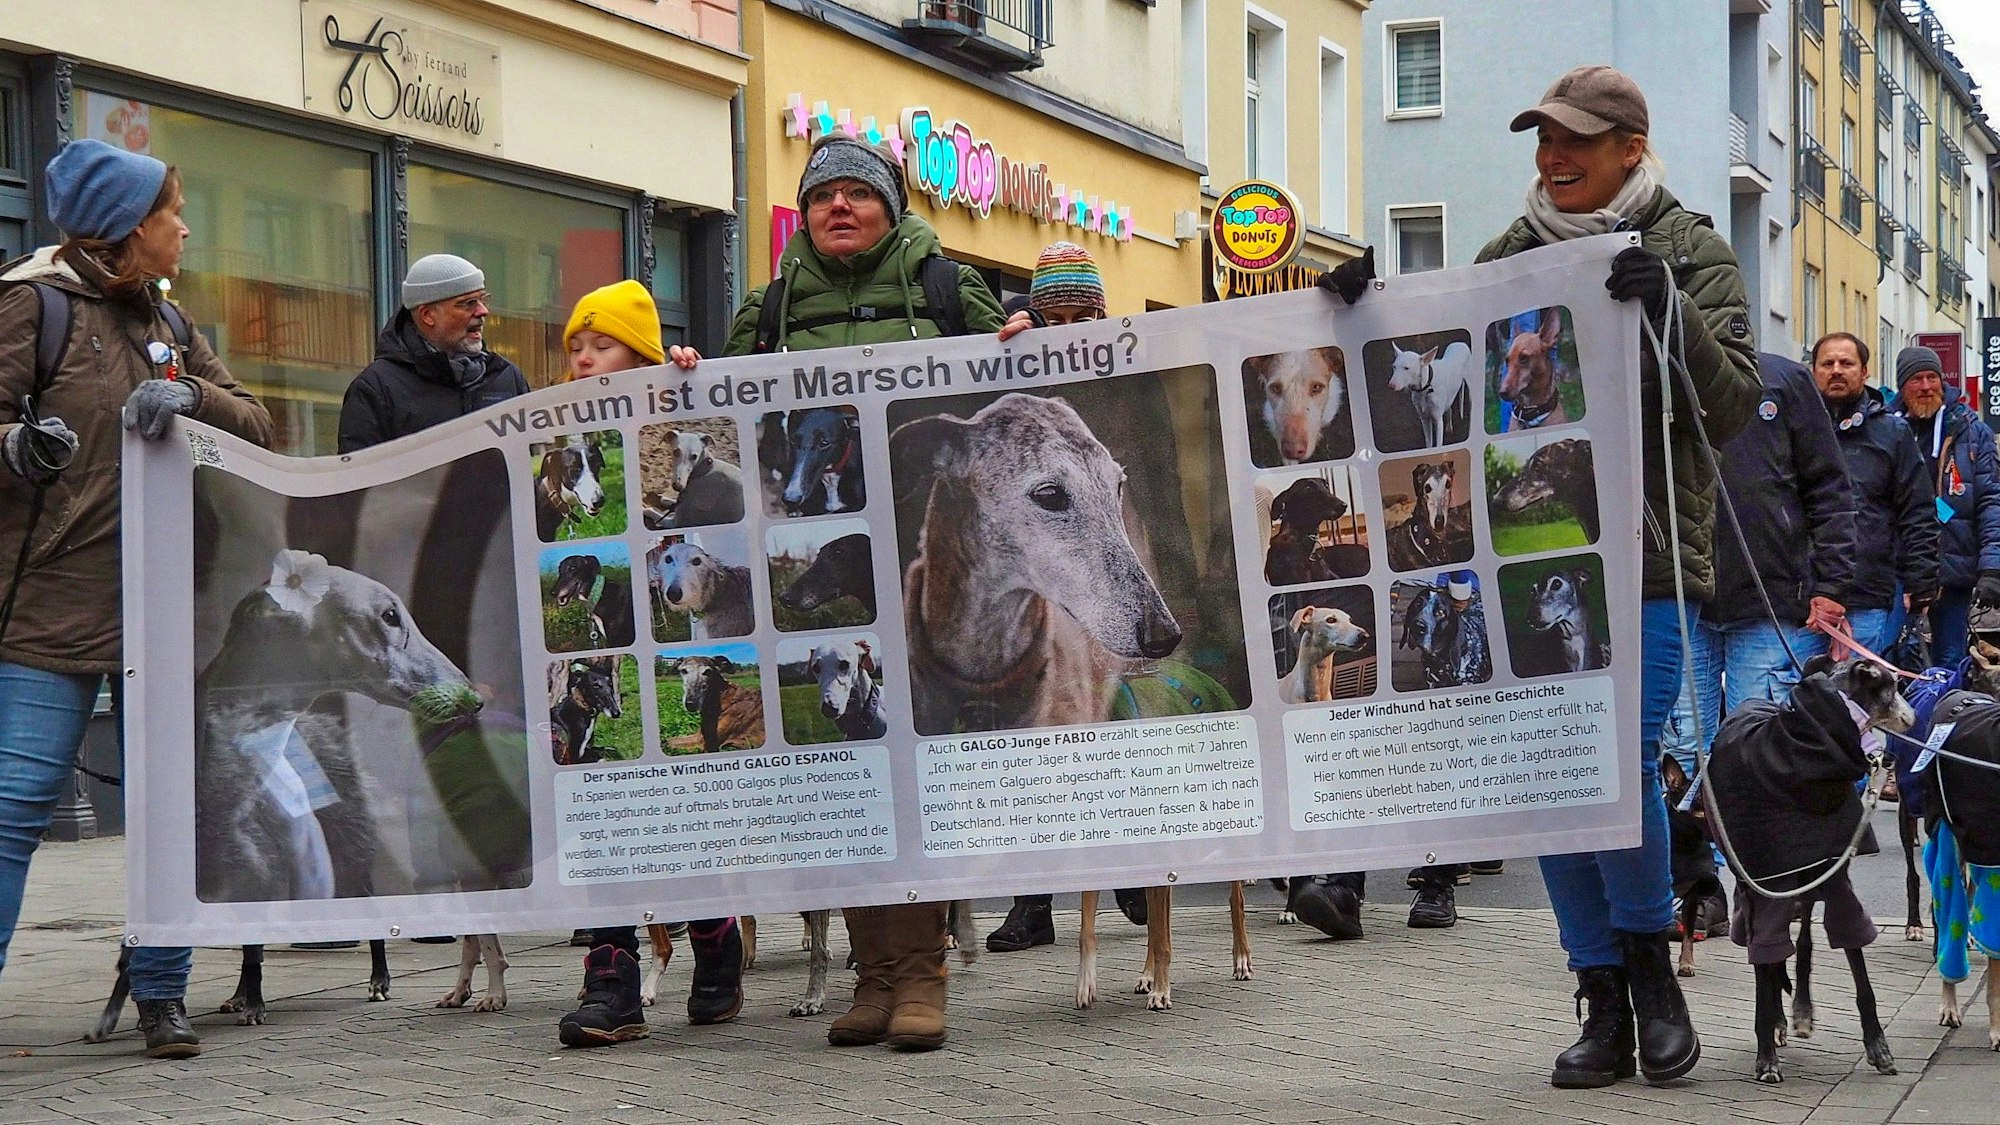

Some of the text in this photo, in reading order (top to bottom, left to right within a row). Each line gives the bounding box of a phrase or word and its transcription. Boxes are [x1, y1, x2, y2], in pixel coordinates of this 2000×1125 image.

[407, 46, 467, 78] by ferrand
[363, 31, 484, 135] Scissors
[1001, 156, 1053, 225] DONUTS
[1231, 186, 1279, 200] DELICIOUS
[1232, 230, 1277, 243] DONUTS
[1231, 255, 1279, 268] MEMORIES
[486, 332, 1139, 437] Warum ist der Marsch wichtig?
[1987, 336, 2000, 415] ace & tate
[1329, 685, 1564, 721] Jeder Windhund hat seine Geschichte
[928, 720, 1240, 755] Auch GALGO-Junge FABIO erzählt seine Geschichte:
[1294, 701, 1607, 744] Wenn ein spanischer Jagdhund seinen Dienst erfüllt hat,
[955, 739, 1247, 772] war ein guter Jäger wurde dennoch mit 7 Jahren
[1305, 722, 1601, 763] wird er oft wie Müll entsorgt, wie ein kaputter Schuh.
[584, 751, 856, 783] Der spanische Windhund GALGO ESPANOL
[925, 759, 1254, 793] von meinem Galguero abgeschafft: Kaum an Umweltreize
[1313, 745, 1597, 782] Hier kommen Hunde zu Wort, die die Jagdtradition
[572, 770, 859, 803] In Spanien werden ca. 50.000 Galgos plus Podencos
[923, 777, 1259, 815] gewöhnt mit panischer Angst vor Männern kam ich nach
[1314, 766, 1599, 804] Spaniens überlebt haben, und erzählen ihre eigene
[566, 788, 881, 822] andere Jagdhunde auf oftmals brutale Art und Weise ent-
[930, 798, 1254, 831] Deutschland. Hier konnte ich Vertrauen fassen habe in
[1304, 787, 1605, 823] Geschichte stellvertretend für ihre Leidensgenossen.
[580, 808, 866, 841] sorgt, wenn sie als nicht mehr jagdtauglich erachtet
[608, 824, 888, 857] Wir protestieren gegen diesen Missbrauch und die
[924, 821, 1198, 851] kleinen Schritten über die Jahre meine Ängste
[632, 844, 887, 874] Haltungs- und Zuchtbedingungen der Hunde.
